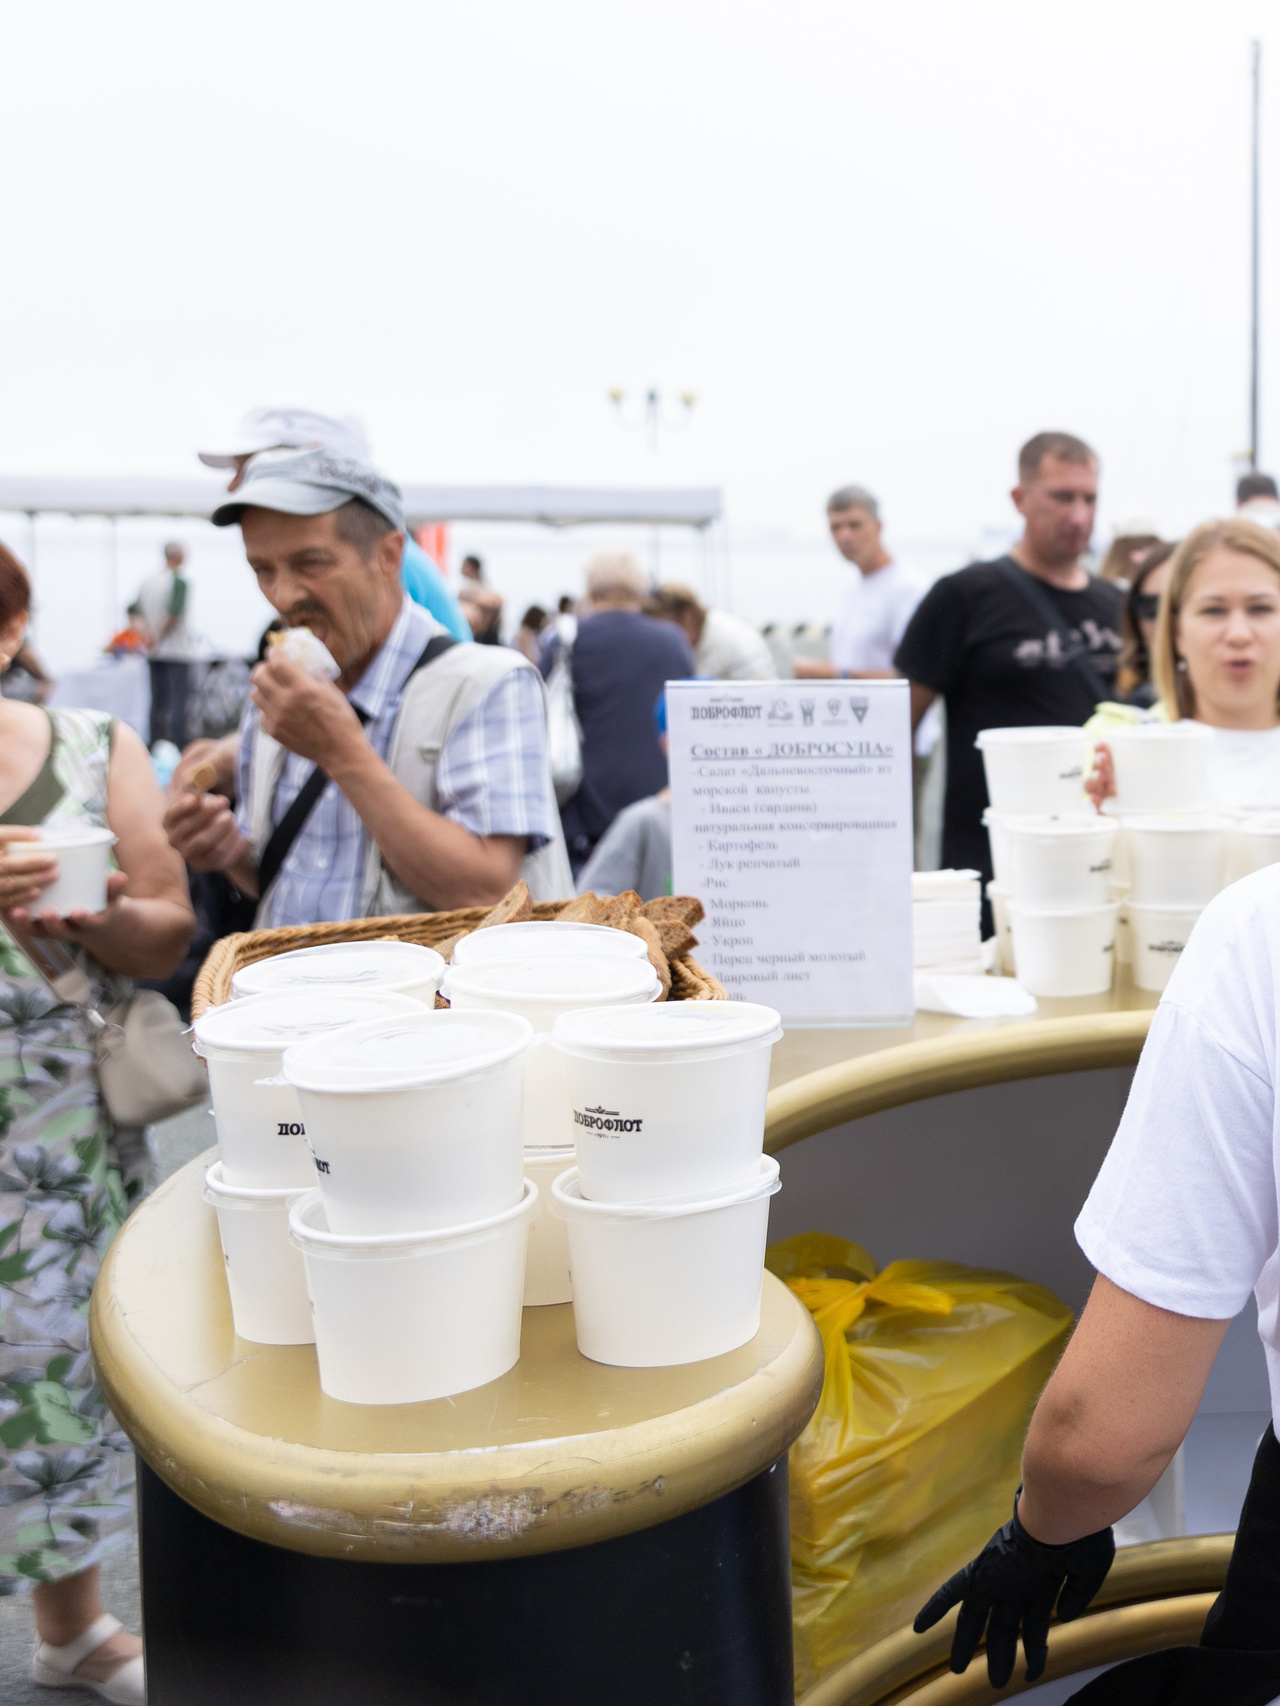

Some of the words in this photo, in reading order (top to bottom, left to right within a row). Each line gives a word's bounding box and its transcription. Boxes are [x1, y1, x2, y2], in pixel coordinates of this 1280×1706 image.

[691, 705, 762, 720] ДОБРОФЛОТ
[691, 743, 749, 757] Состав
[693, 784, 748, 798] морской
[757, 785, 809, 797] капусты
[710, 802, 750, 814] Иваси
[754, 801, 817, 815] (сардина)
[695, 823, 775, 835] натуральная
[779, 820, 897, 834] консервированная
[708, 839, 778, 853] Картофель
[708, 857, 734, 872] Лук
[738, 856, 800, 872] репчатый
[711, 898, 769, 912] Морковь
[712, 916, 746, 929] Яйцо
[712, 935, 753, 948] Укроп
[712, 953, 753, 967] Перец
[757, 951, 805, 966] черный
[808, 949, 866, 962] молотый
[783, 972, 810, 982] лист
[573, 1109, 643, 1132] ДОБРОФЛОТ
